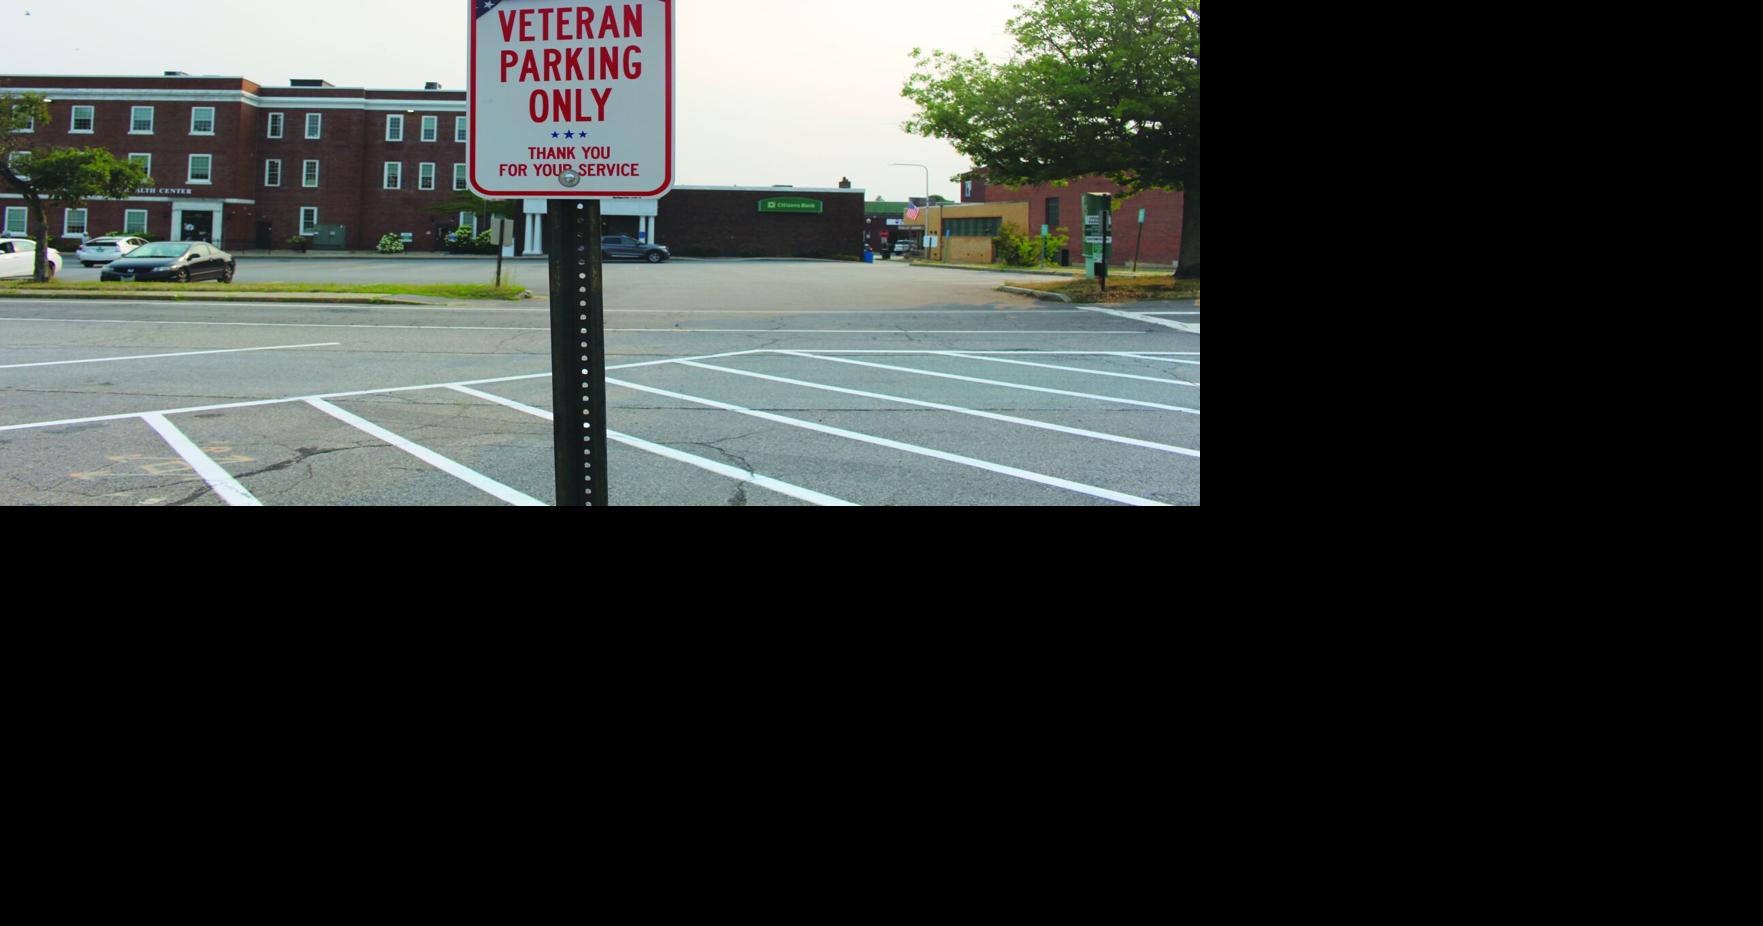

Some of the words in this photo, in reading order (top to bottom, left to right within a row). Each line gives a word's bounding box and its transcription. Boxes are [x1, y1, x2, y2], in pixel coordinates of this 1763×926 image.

[498, 4, 643, 42] VETERAN
[500, 45, 642, 82] PARKING
[529, 88, 612, 123] ONLY
[499, 163, 527, 176] FOR
[578, 163, 639, 176] SERVICE
[528, 146, 575, 160] THANK
[581, 146, 610, 160] YOU
